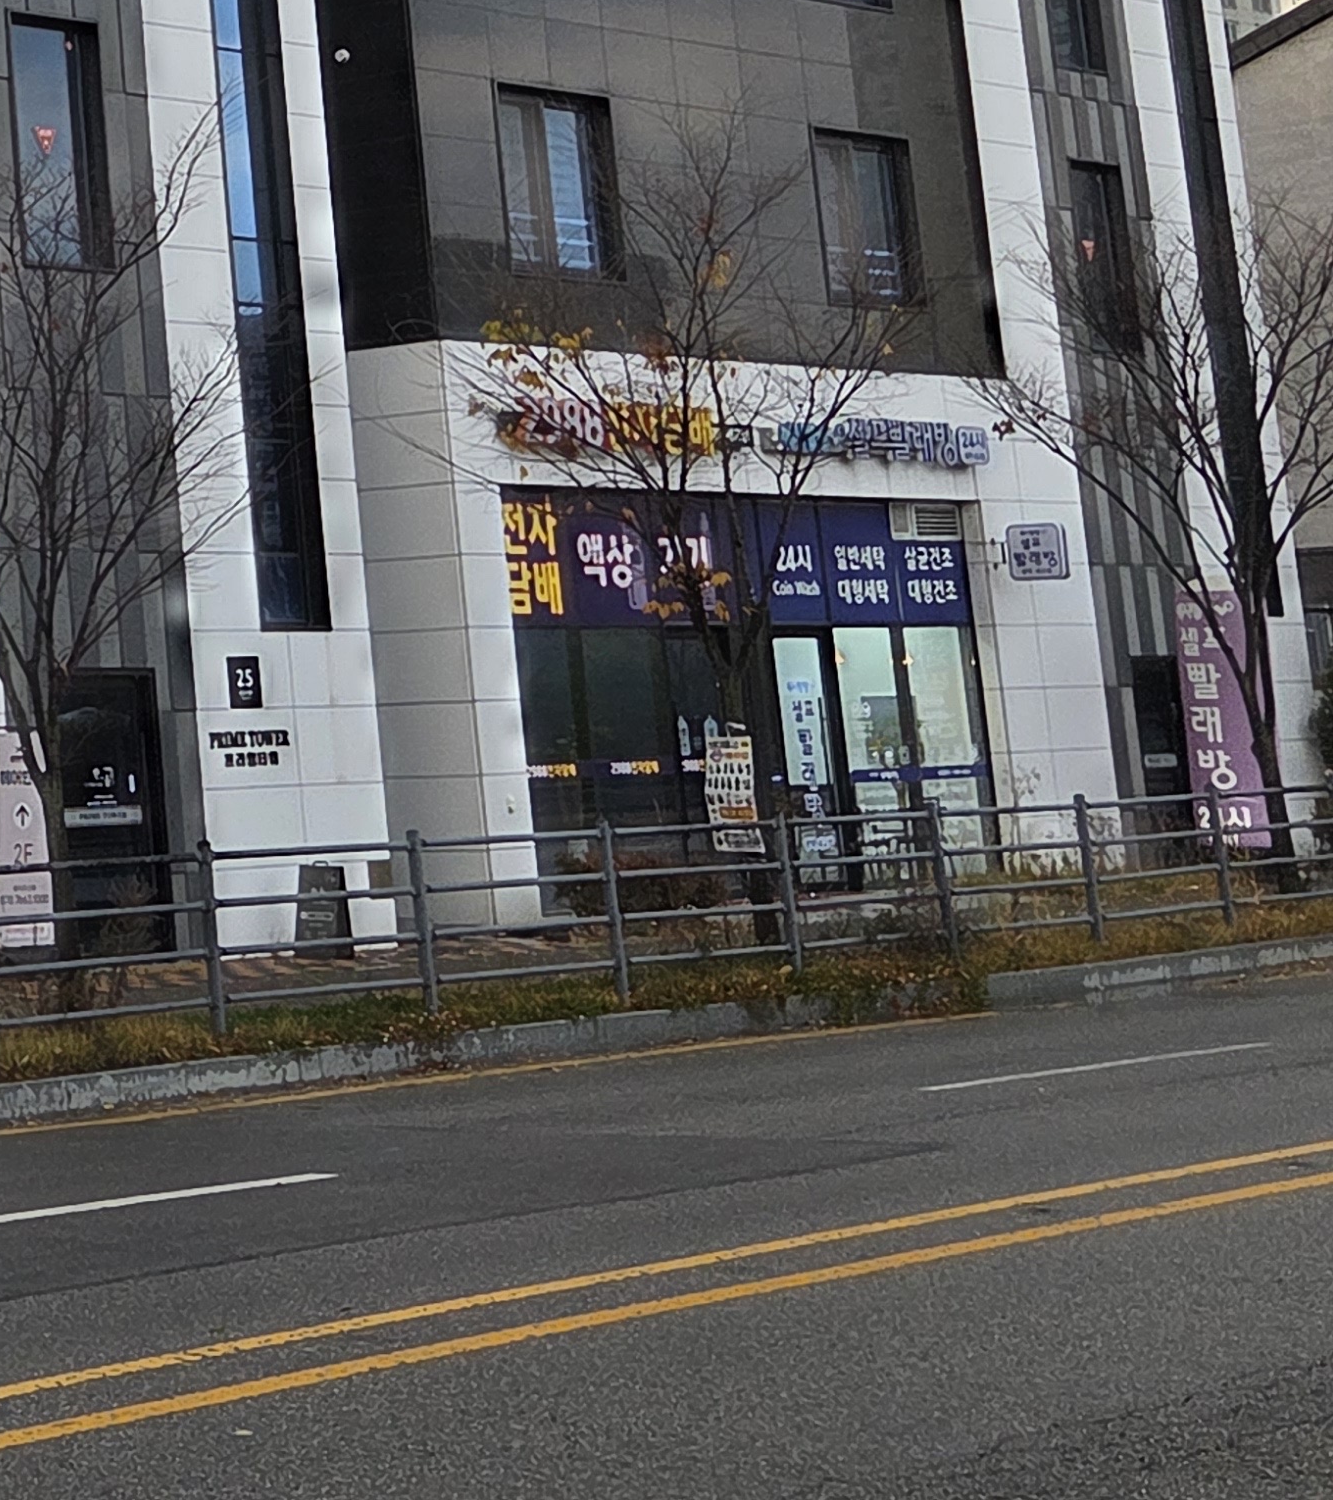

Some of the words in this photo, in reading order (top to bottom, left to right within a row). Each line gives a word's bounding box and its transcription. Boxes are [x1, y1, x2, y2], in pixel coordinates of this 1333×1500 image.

[576, 533, 634, 589] 액상
[834, 545, 886, 571] 일반세탁
[904, 546, 955, 572] 살균건조
[507, 560, 565, 615] 담배
[907, 579, 959, 604] 대형건조
[235, 668, 254, 688] 25
[1185, 662, 1238, 791] 빨래방
